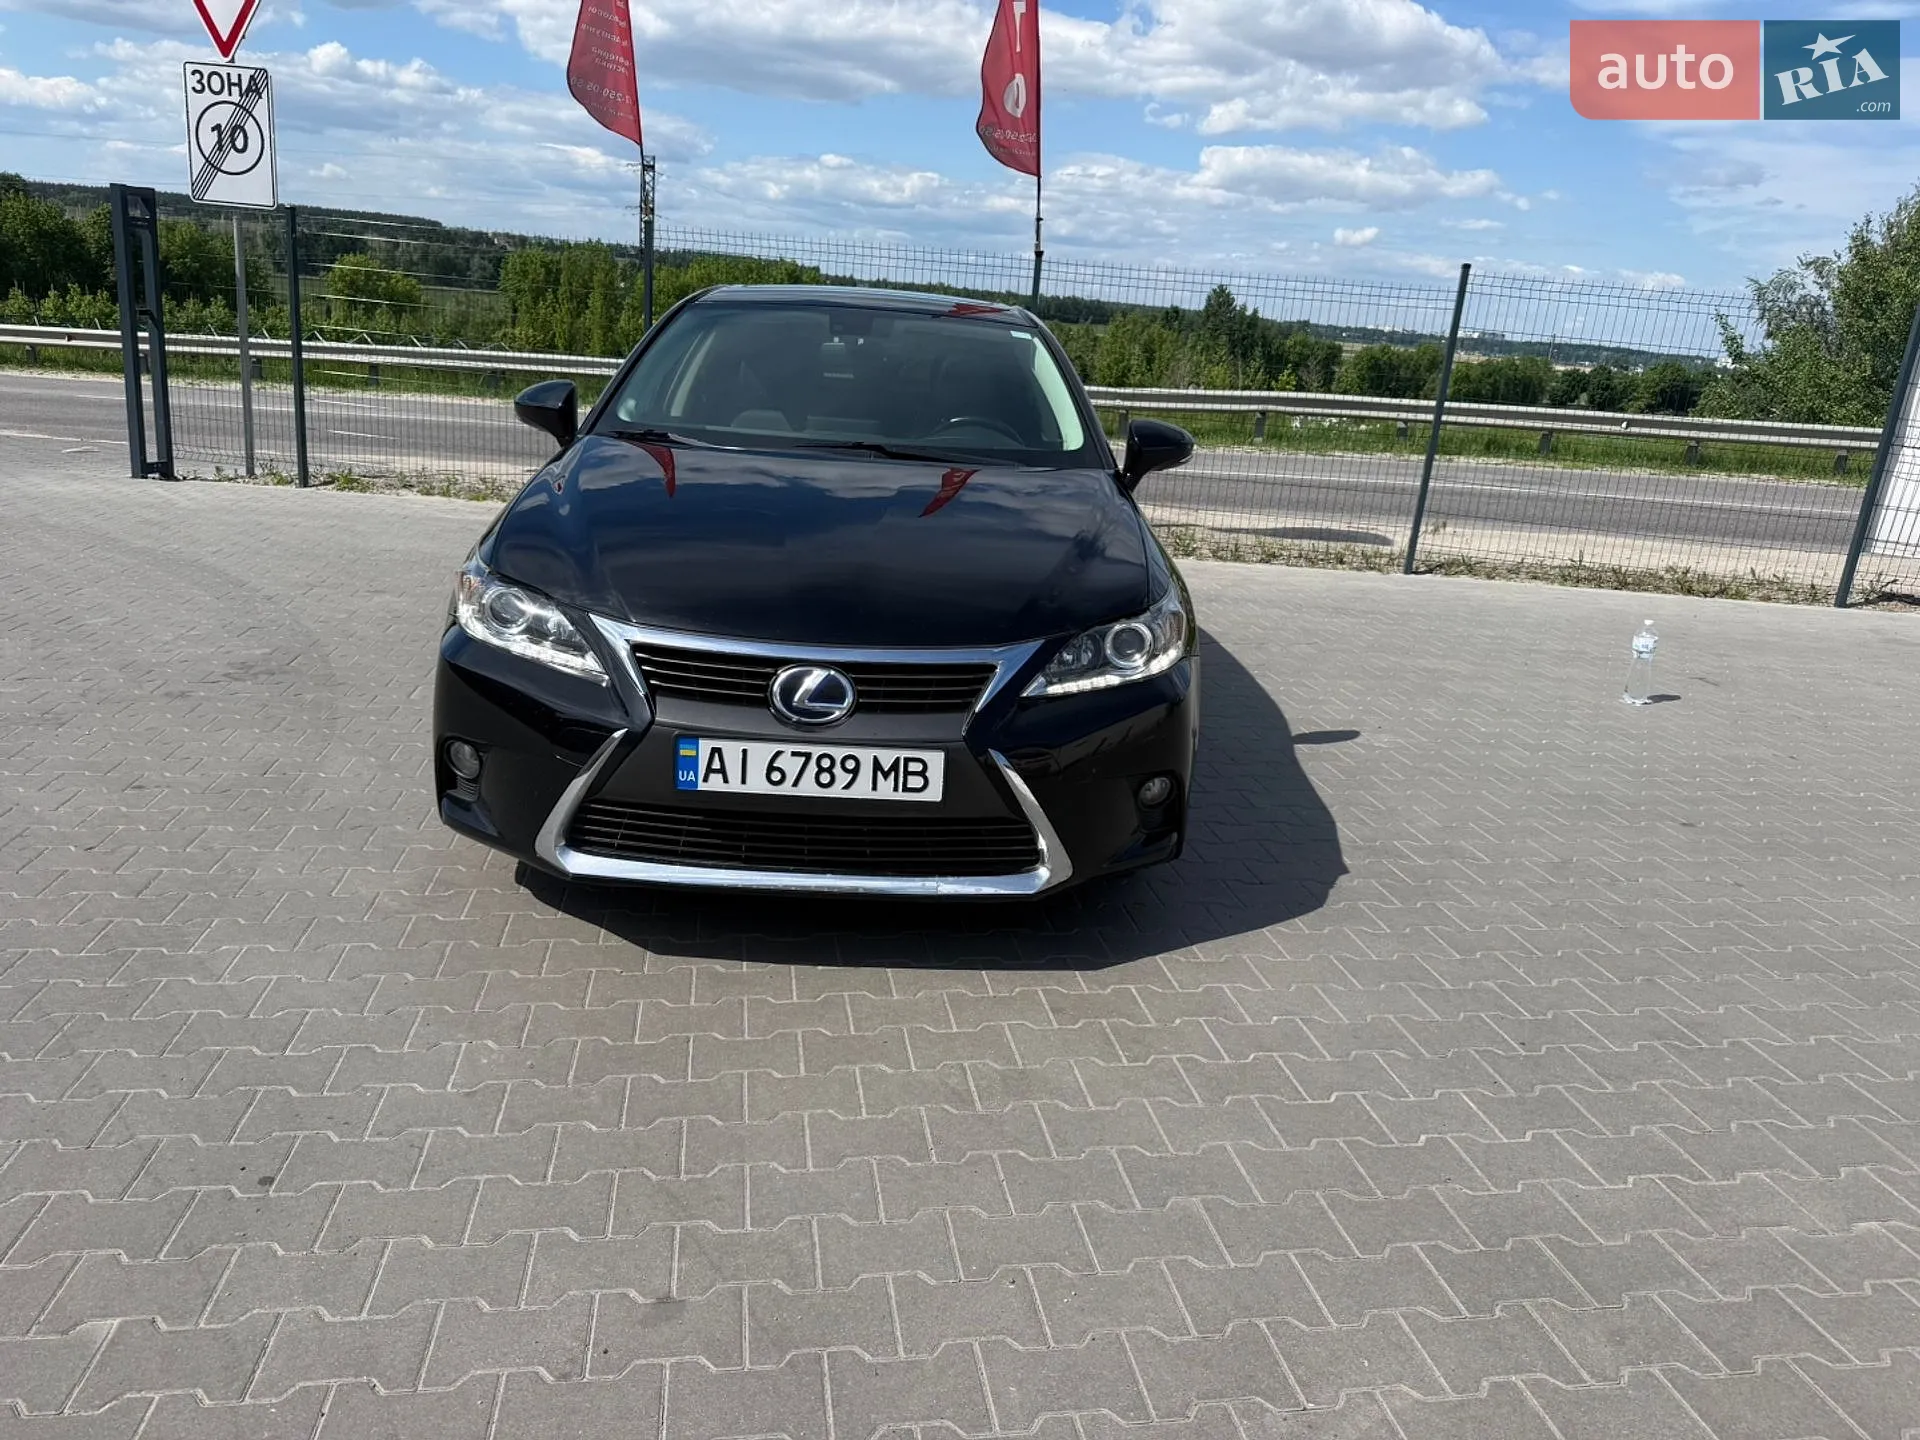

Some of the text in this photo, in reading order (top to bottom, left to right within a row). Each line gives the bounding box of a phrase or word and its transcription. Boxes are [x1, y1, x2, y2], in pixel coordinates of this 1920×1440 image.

[190, 69, 263, 100] ЗОНА
[210, 122, 249, 154] 10
[678, 770, 696, 783] UA
[702, 746, 929, 793] AI 6789 MB
